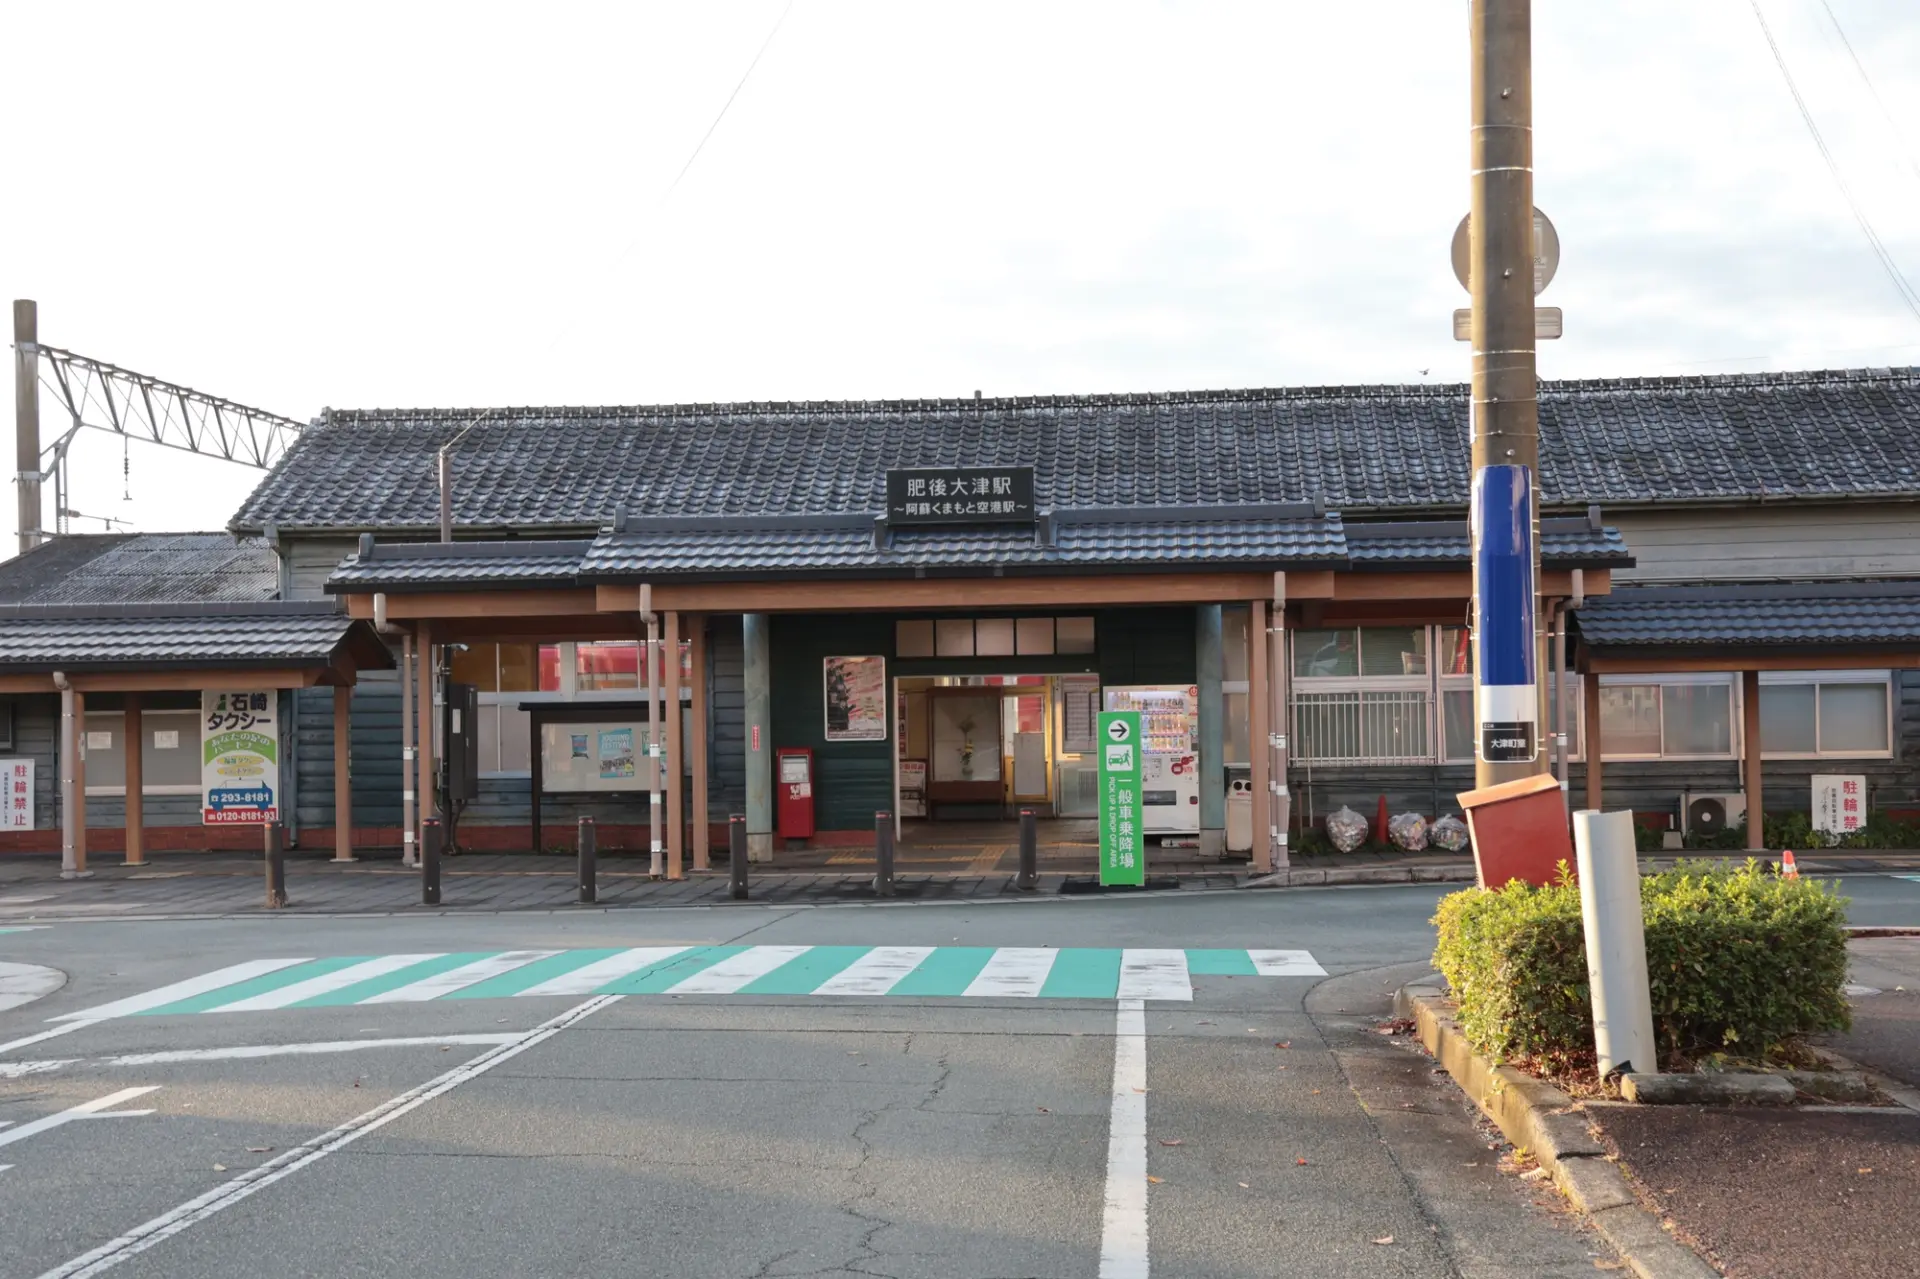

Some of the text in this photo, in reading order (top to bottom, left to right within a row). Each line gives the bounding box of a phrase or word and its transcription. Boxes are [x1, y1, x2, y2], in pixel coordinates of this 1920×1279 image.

[907, 477, 1012, 497] 肥後大津駅
[207, 712, 271, 731] タクシー
[1108, 776, 1117, 793] PICK
[14, 764, 28, 826] 駐輪禁止
[220, 792, 269, 802] 293-8181
[1109, 794, 1117, 805] UP
[1843, 780, 1858, 829] 駐輪禁
[216, 811, 275, 821] 0120-8181-93
[1109, 812, 1117, 832] DROP
[1117, 778, 1135, 869] 一般車乗降場
[1109, 848, 1118, 868] AREA
